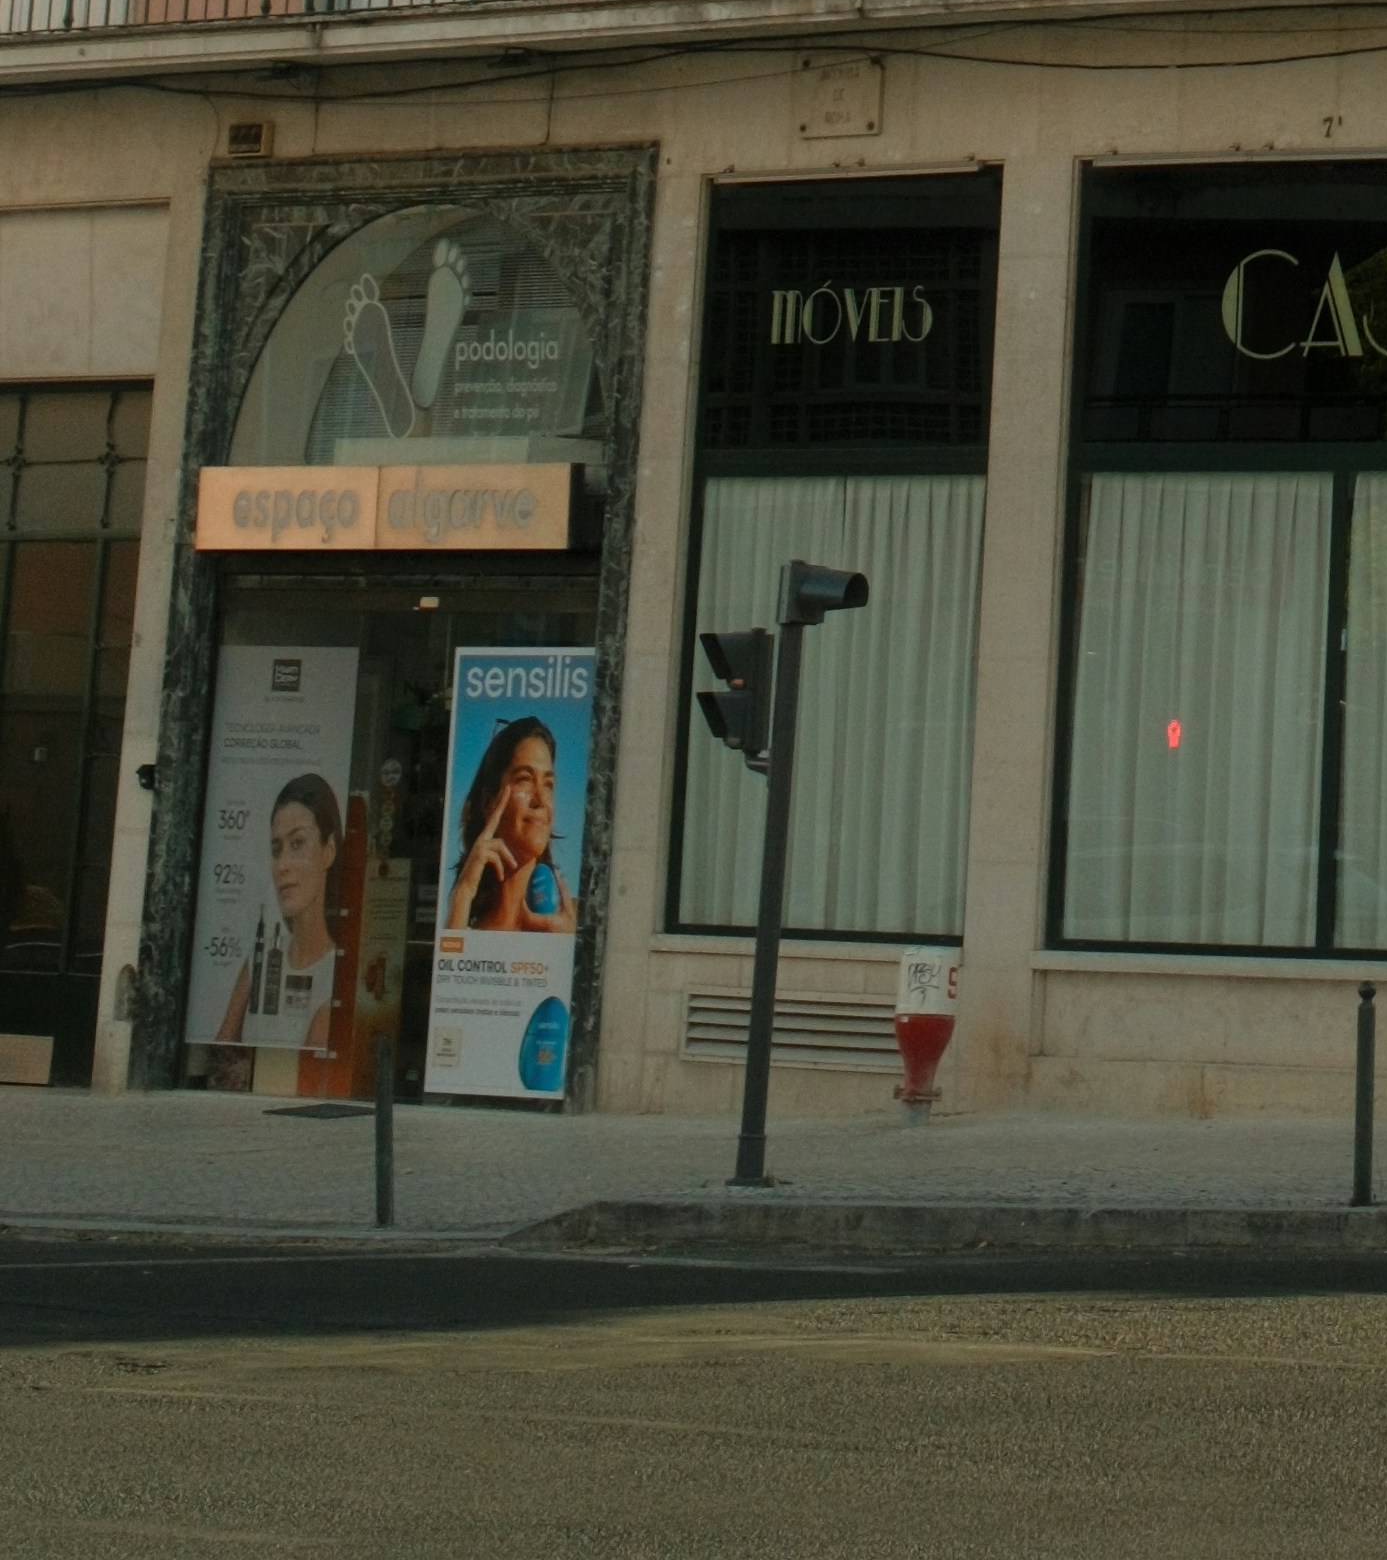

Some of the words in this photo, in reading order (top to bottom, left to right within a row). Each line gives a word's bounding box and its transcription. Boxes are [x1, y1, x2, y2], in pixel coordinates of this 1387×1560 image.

[770, 279, 934, 345] MÓVEIS
[455, 328, 560, 371] podologia
[232, 488, 360, 543] espaço
[387, 467, 538, 543] algarve
[465, 656, 589, 699] sensilis
[213, 863, 246, 885] 92%
[204, 936, 242, 958] -56%
[438, 959, 454, 972] OIL
[457, 959, 507, 973] CONTROL
[510, 961, 549, 975] SPF50+
